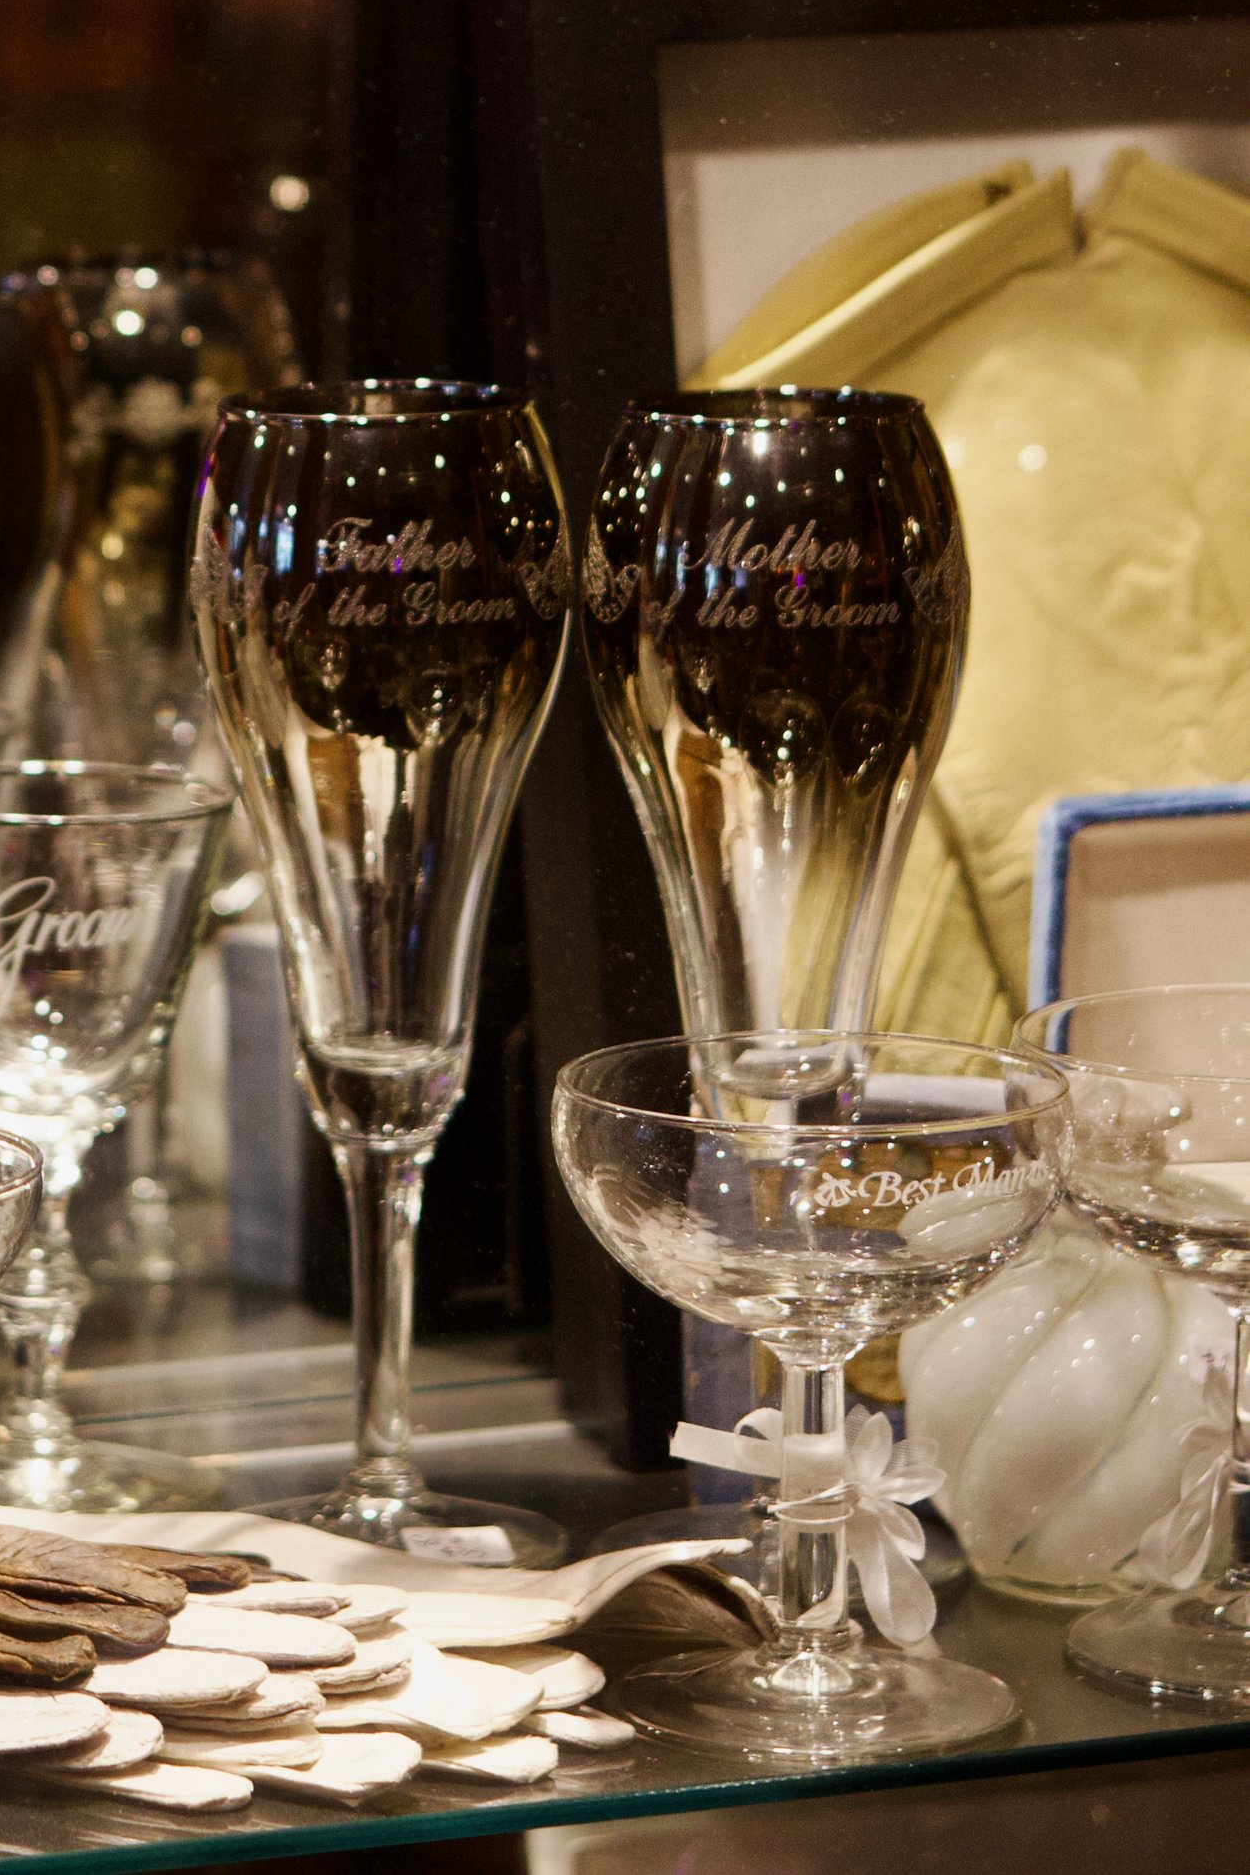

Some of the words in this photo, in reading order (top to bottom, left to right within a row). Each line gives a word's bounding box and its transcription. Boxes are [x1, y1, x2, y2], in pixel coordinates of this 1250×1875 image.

[317, 516, 477, 573] Father
[681, 516, 862, 572] Mother
[273, 582, 316, 643] of
[328, 583, 388, 626] the
[402, 580, 517, 626] Groom
[695, 585, 758, 629] the
[774, 583, 901, 628] Groom
[858, 1170, 947, 1208] Best
[952, 1161, 1028, 1200] Man
